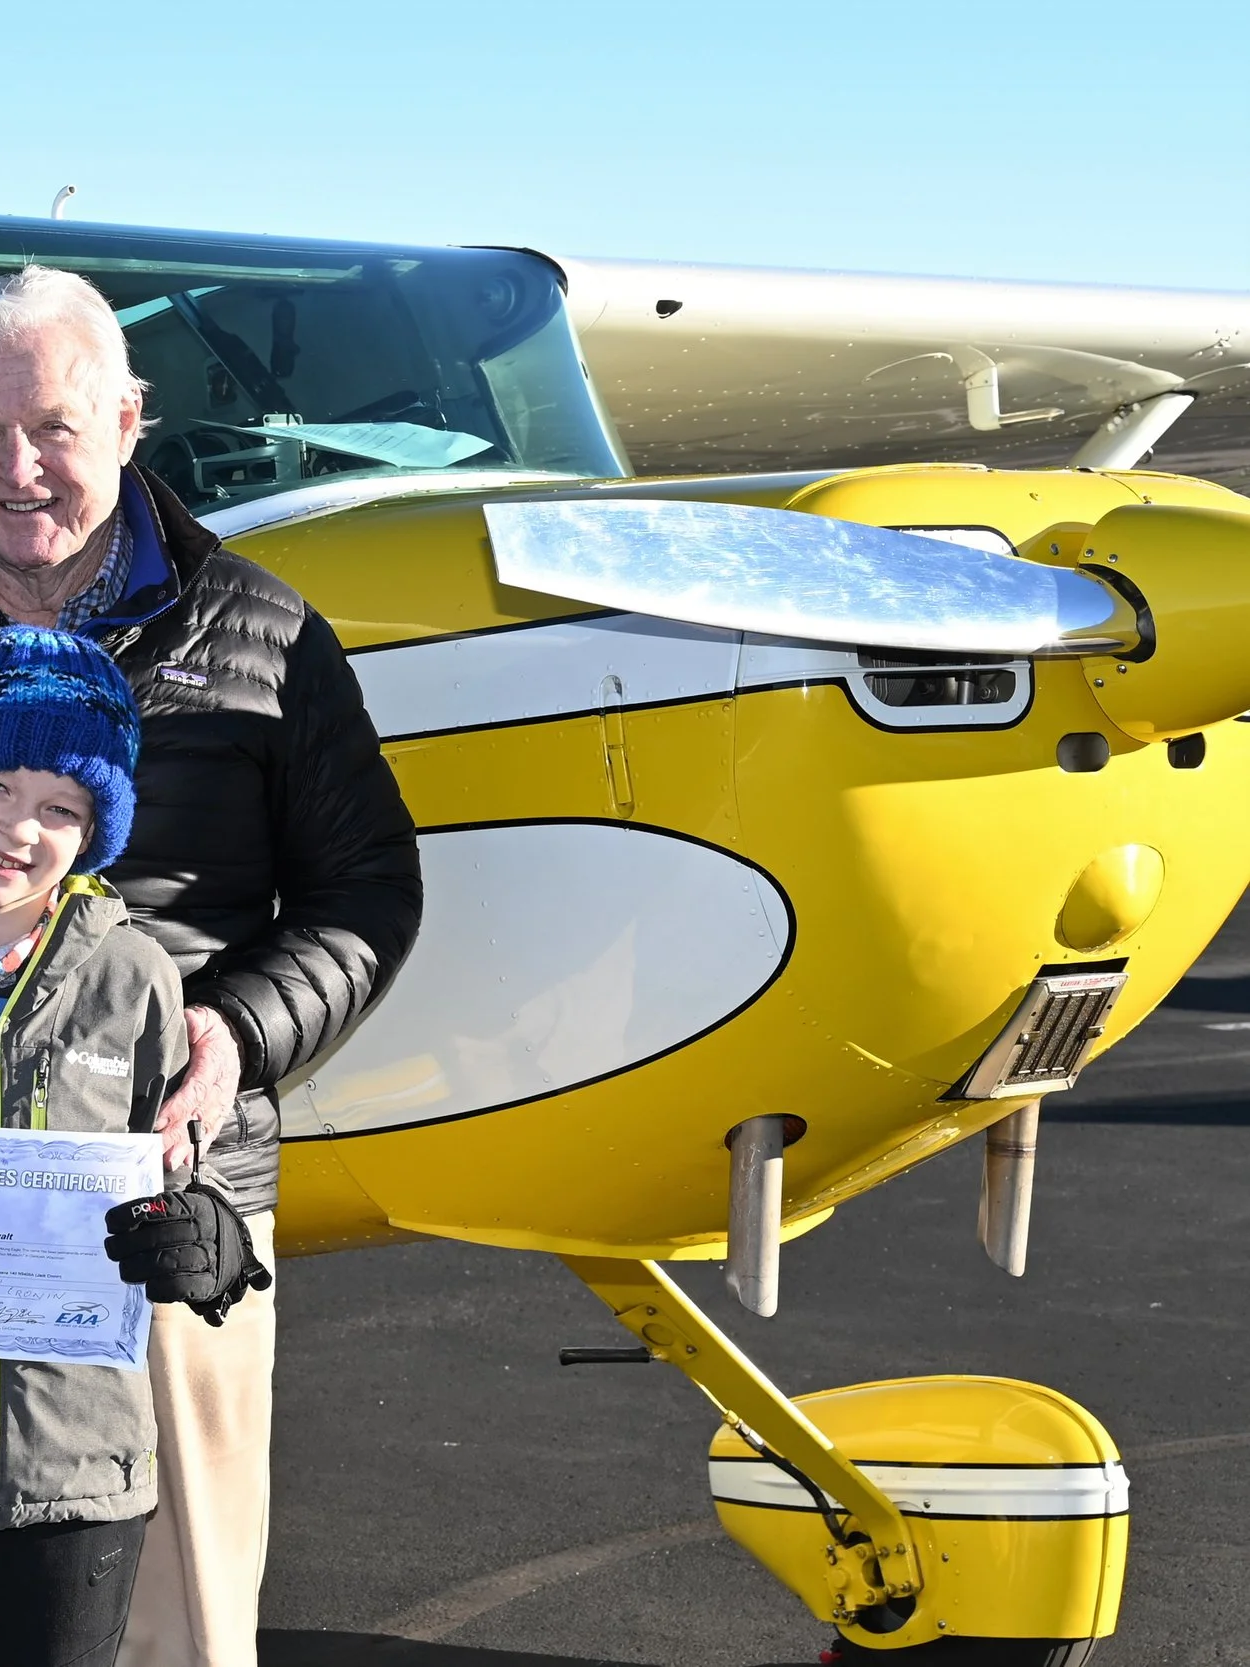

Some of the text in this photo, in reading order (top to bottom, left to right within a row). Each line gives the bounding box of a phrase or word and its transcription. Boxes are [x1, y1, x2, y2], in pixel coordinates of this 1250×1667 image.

[78, 1051, 130, 1069] Columbia
[20, 1170, 126, 1194] CERTIFICATE
[54, 1312, 99, 1326] EAA
